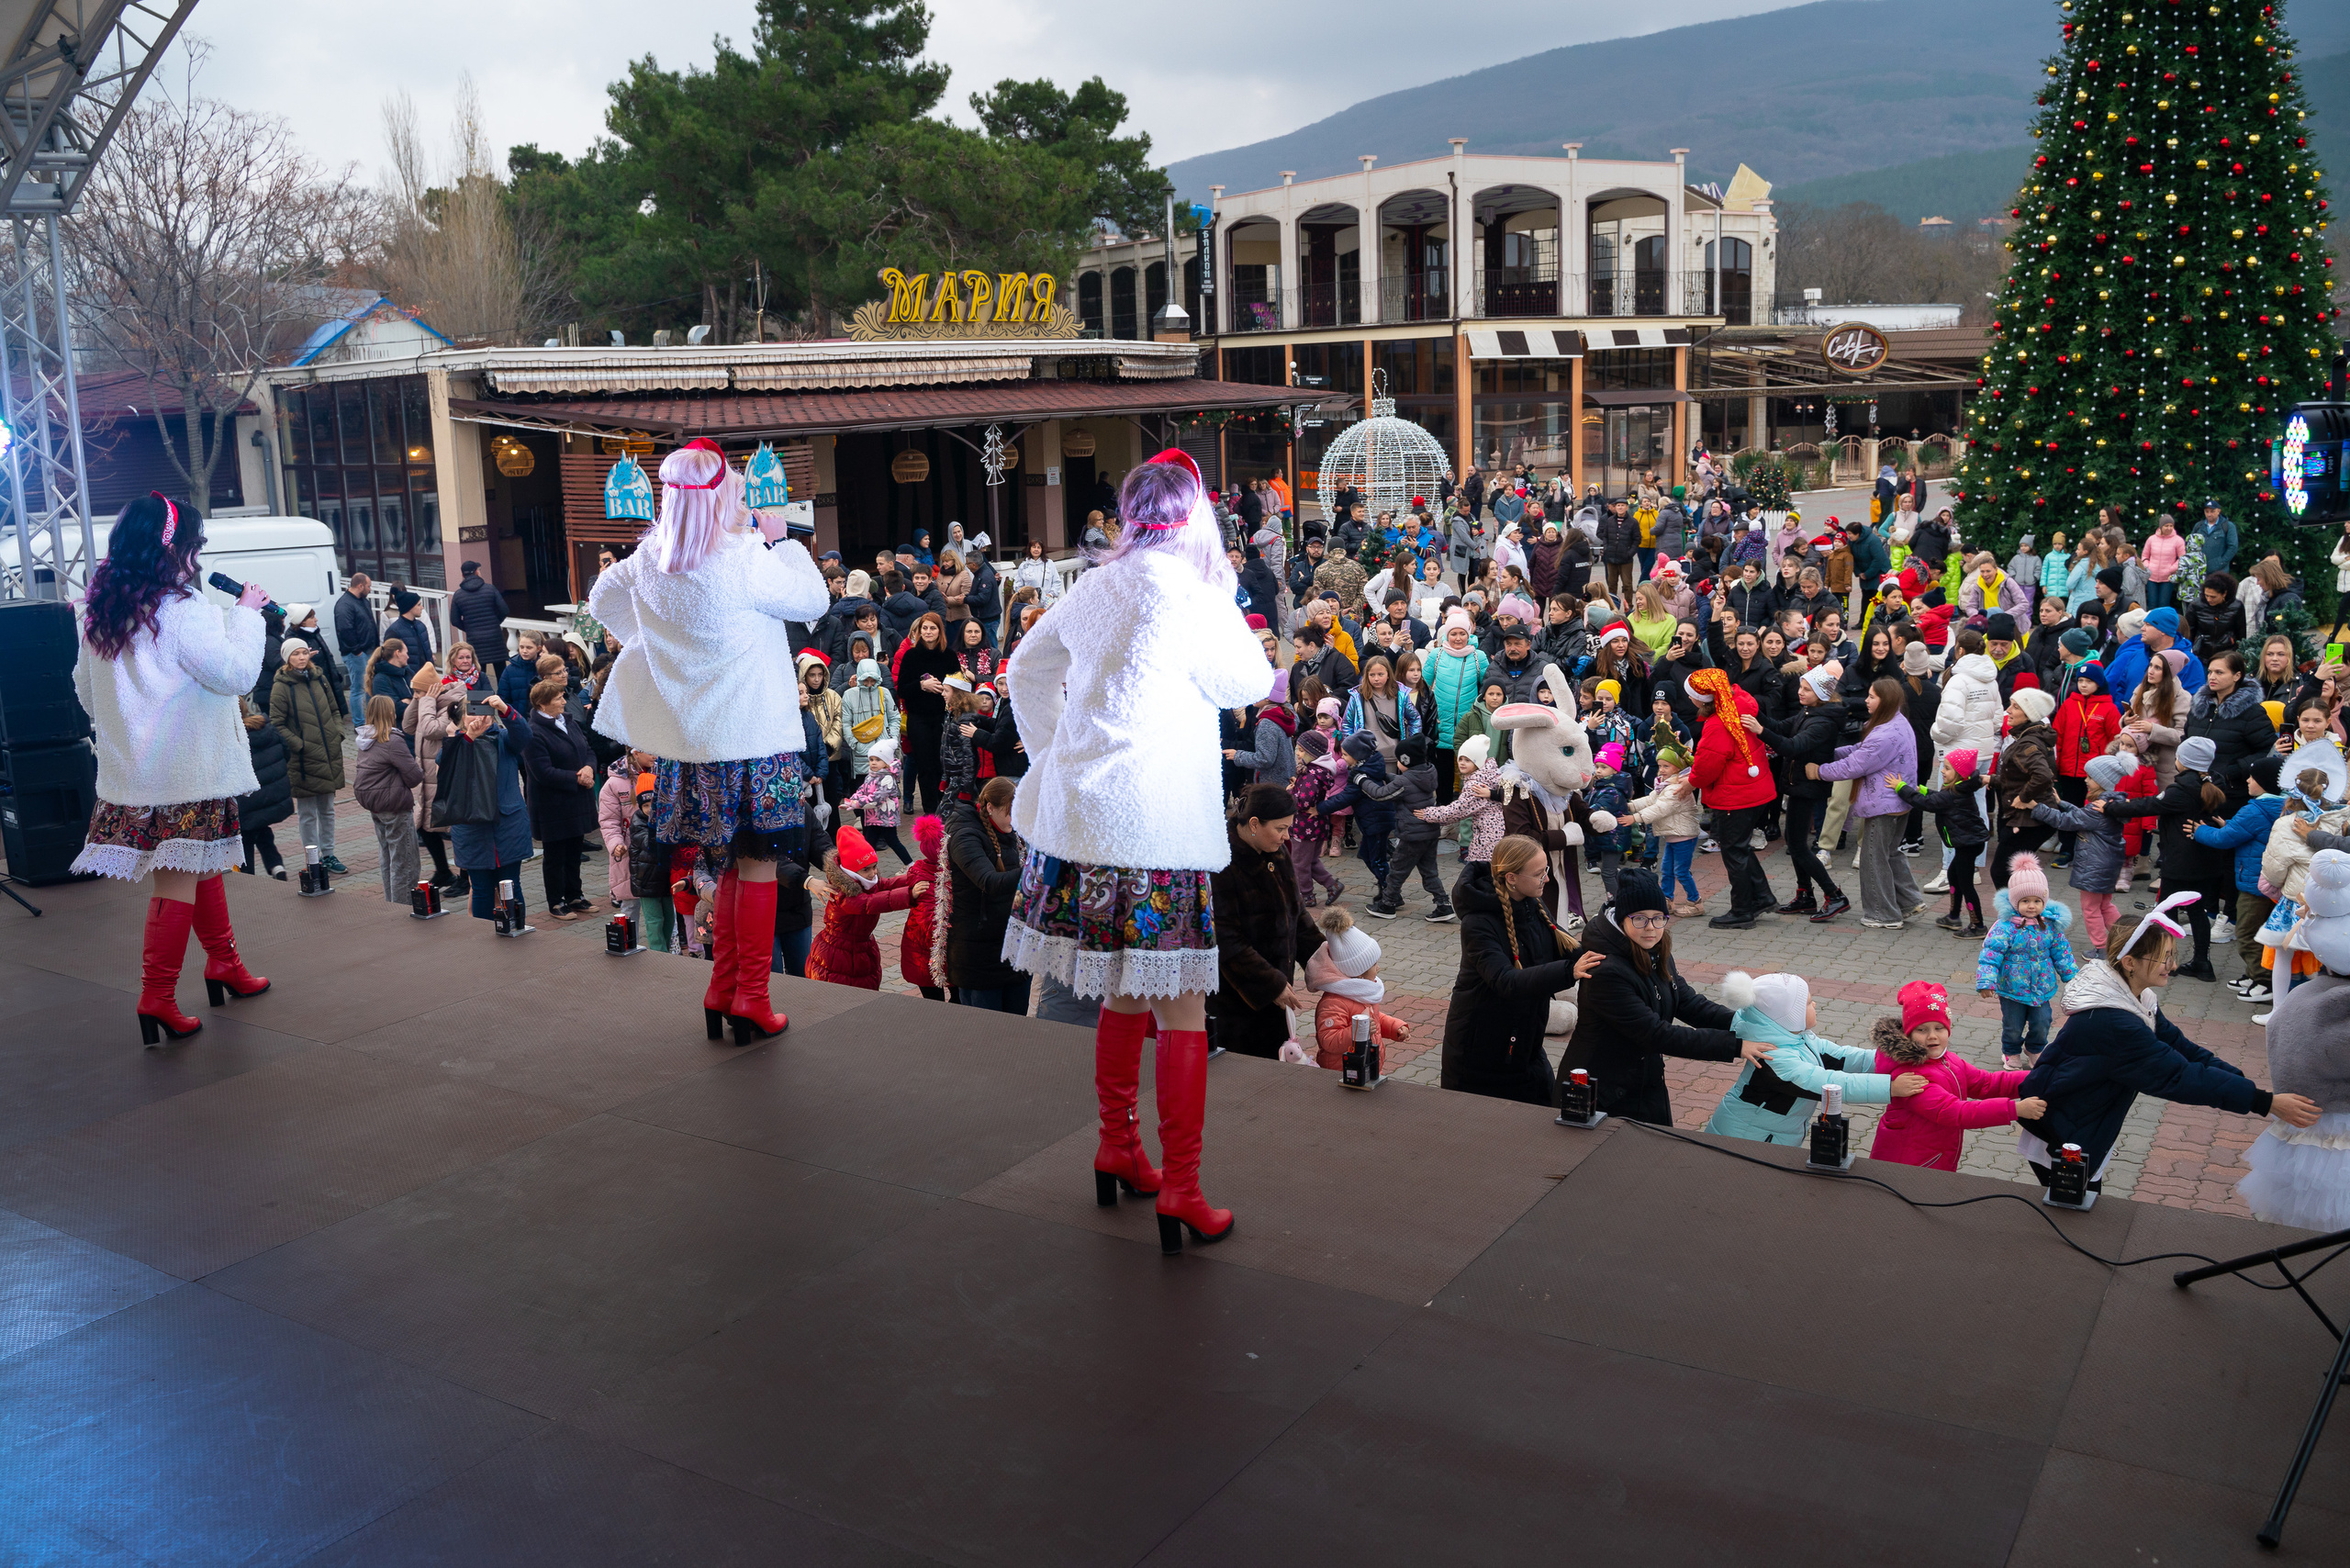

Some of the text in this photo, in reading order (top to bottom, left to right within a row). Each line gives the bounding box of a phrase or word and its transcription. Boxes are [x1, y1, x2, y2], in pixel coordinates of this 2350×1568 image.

[1202, 230, 1211, 278] БАЛКОН
[879, 266, 1056, 323] МАРИЯ
[607, 497, 653, 519] BAR
[749, 485, 787, 508] BAR
